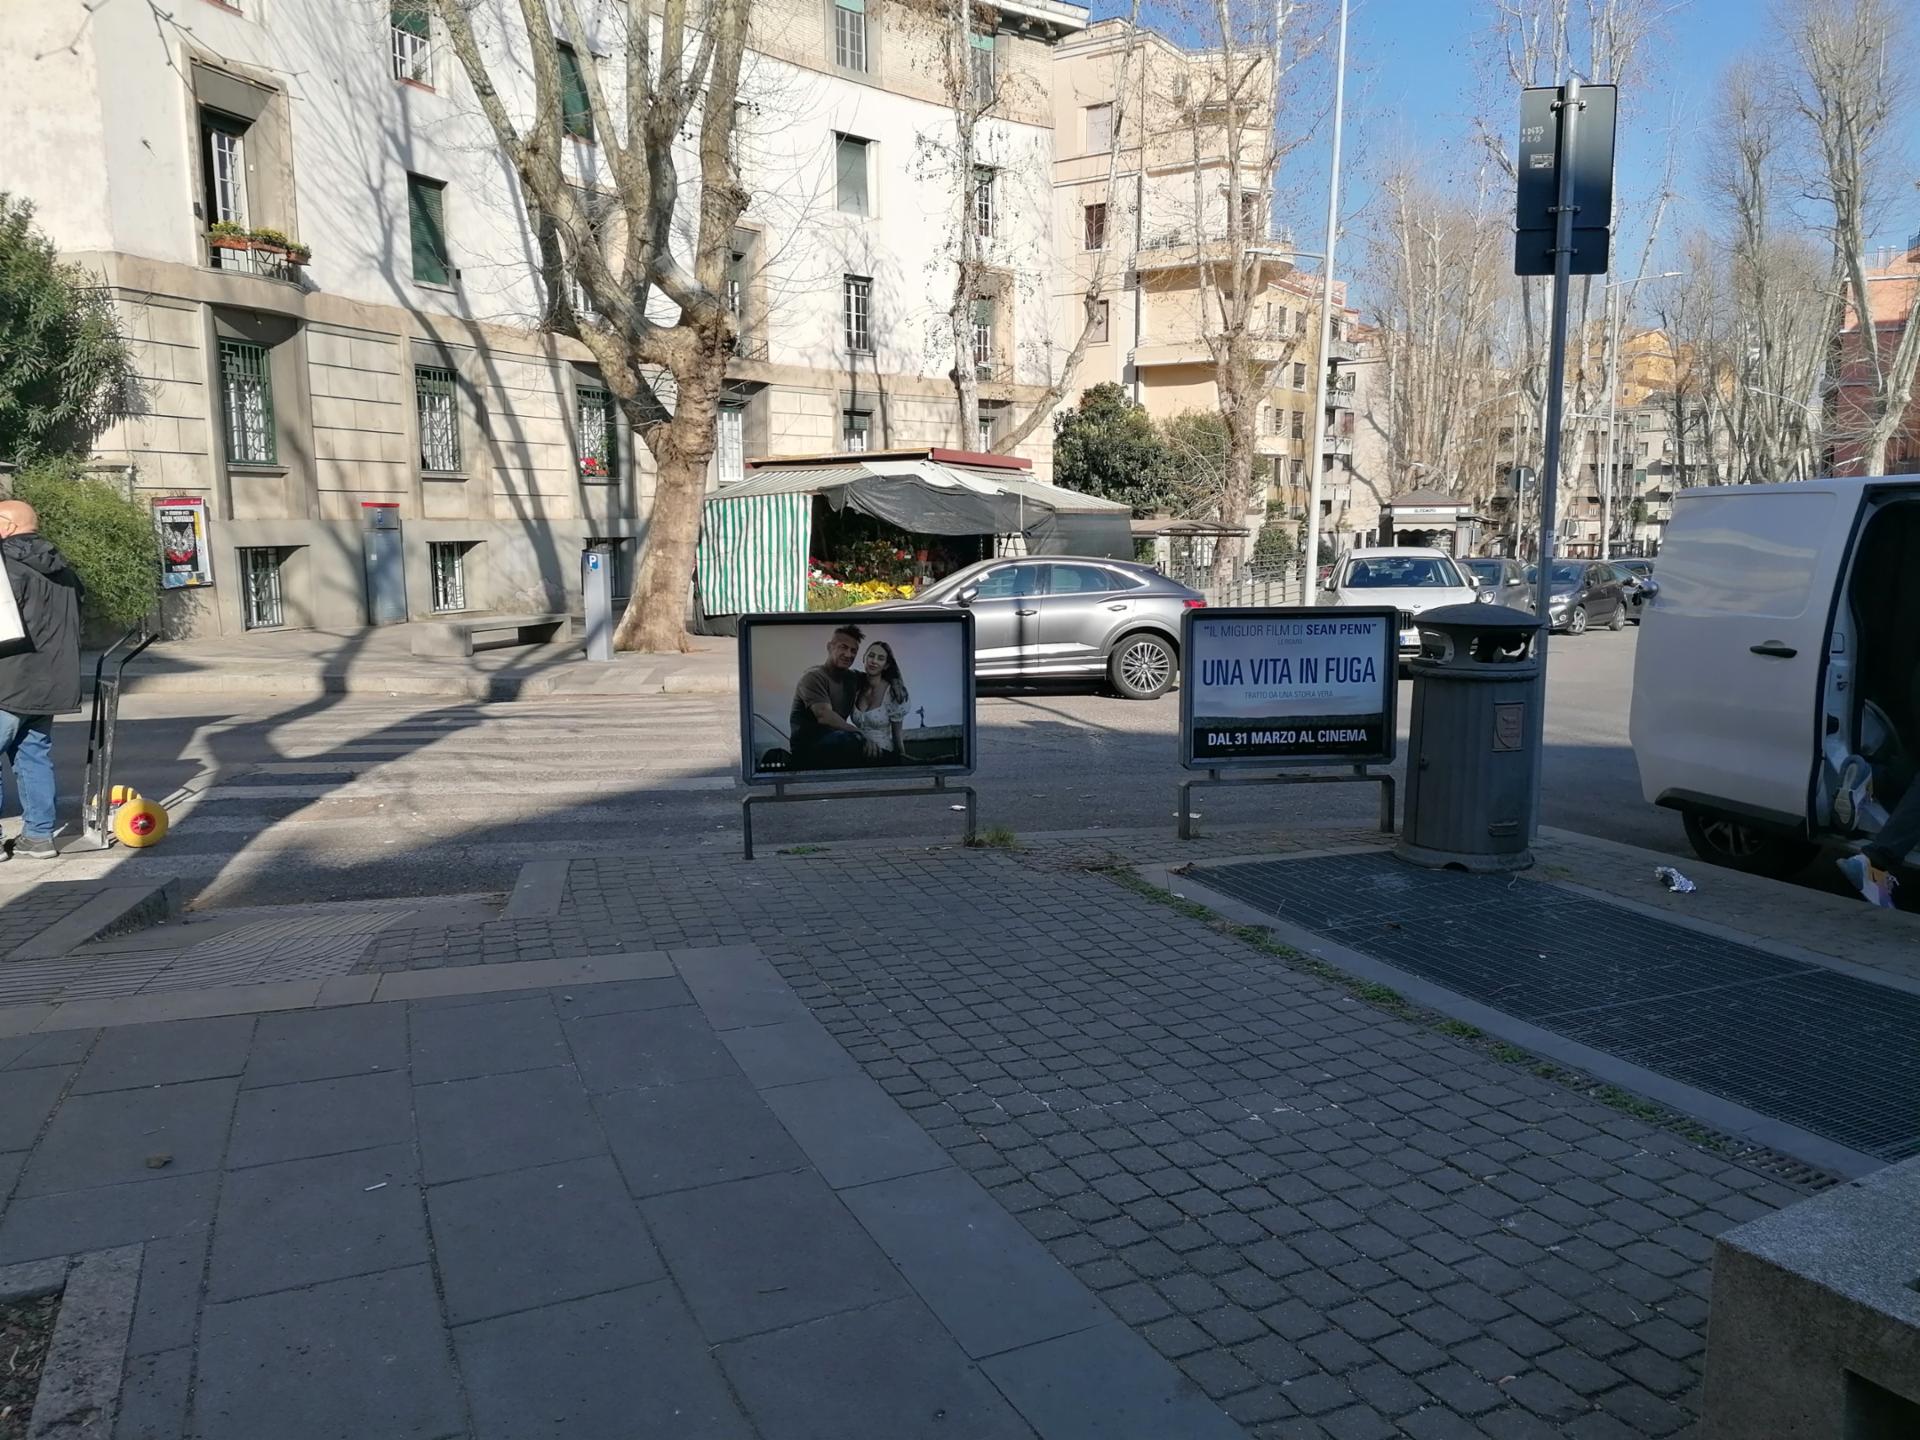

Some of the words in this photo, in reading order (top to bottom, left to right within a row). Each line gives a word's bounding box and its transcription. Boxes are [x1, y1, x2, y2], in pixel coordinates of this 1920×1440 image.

[1220, 624, 1263, 637] MIGLIOR
[1266, 624, 1290, 637] FILM
[1293, 624, 1303, 636] DI
[1306, 623, 1337, 635] SEAN
[1202, 659, 1244, 686] UNA
[1250, 658, 1292, 685] VITA
[1300, 657, 1318, 684] IN
[1325, 656, 1376, 684] FUGA
[1245, 691, 1267, 699] TRATTO
[1317, 690, 1333, 698] VERA
[1208, 733, 1232, 746] DAL
[1235, 733, 1247, 745] 31
[1251, 731, 1296, 744] MARZO
[1299, 731, 1315, 743] AL
[1318, 729, 1367, 742] CINEMA
